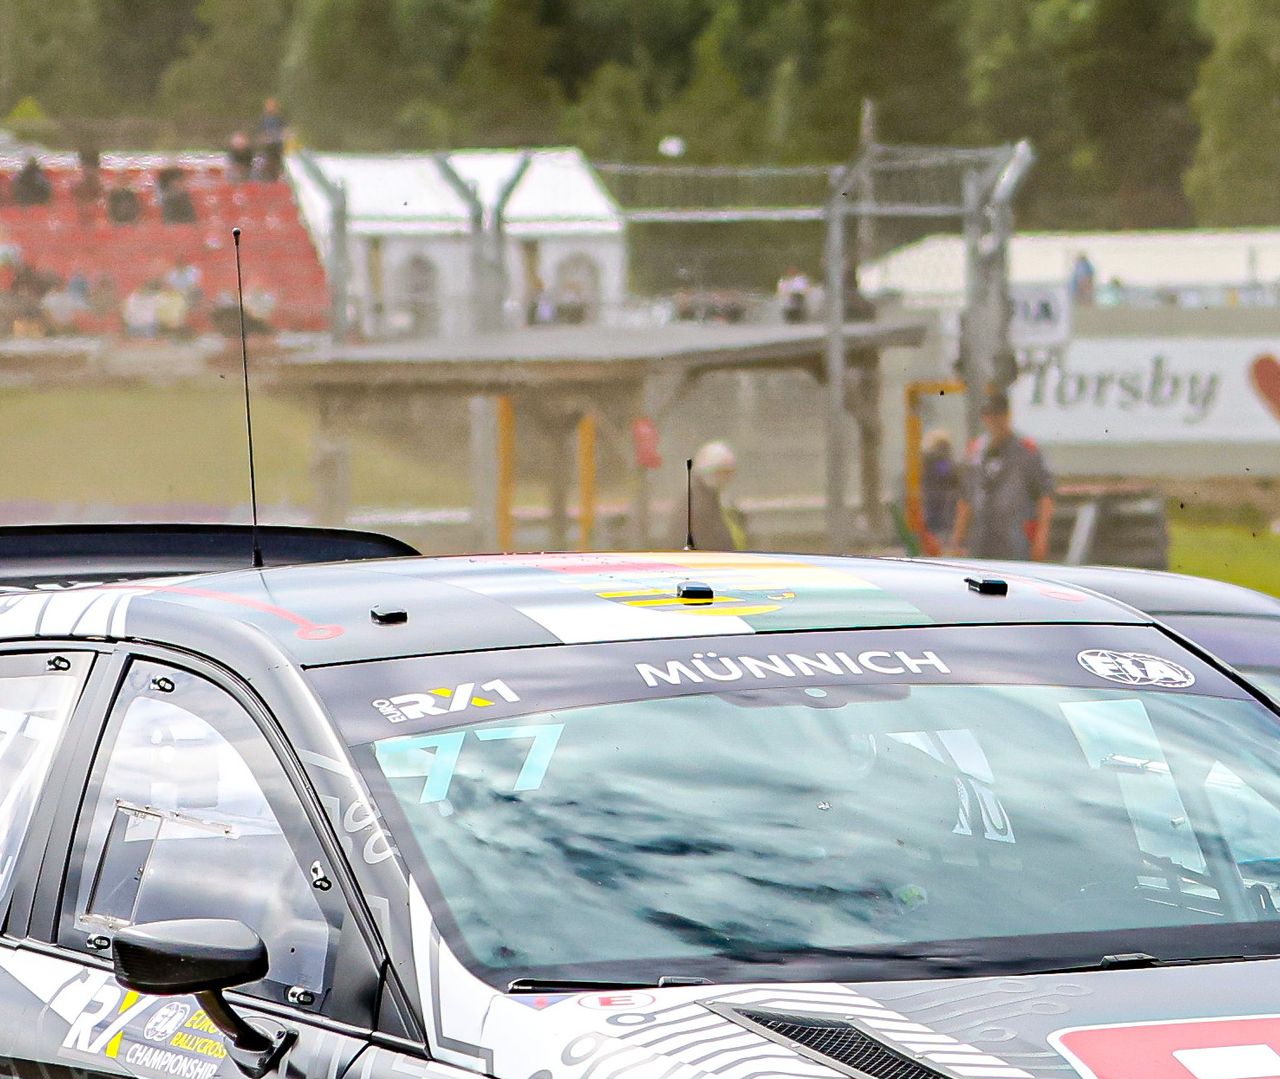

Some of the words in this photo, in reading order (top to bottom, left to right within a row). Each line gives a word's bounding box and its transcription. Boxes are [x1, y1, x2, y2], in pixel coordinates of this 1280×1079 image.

[634, 651, 951, 687] MÜNNICH
[1079, 651, 1194, 687] FIA
[170, 1031, 227, 1058] RALLYCROSS
